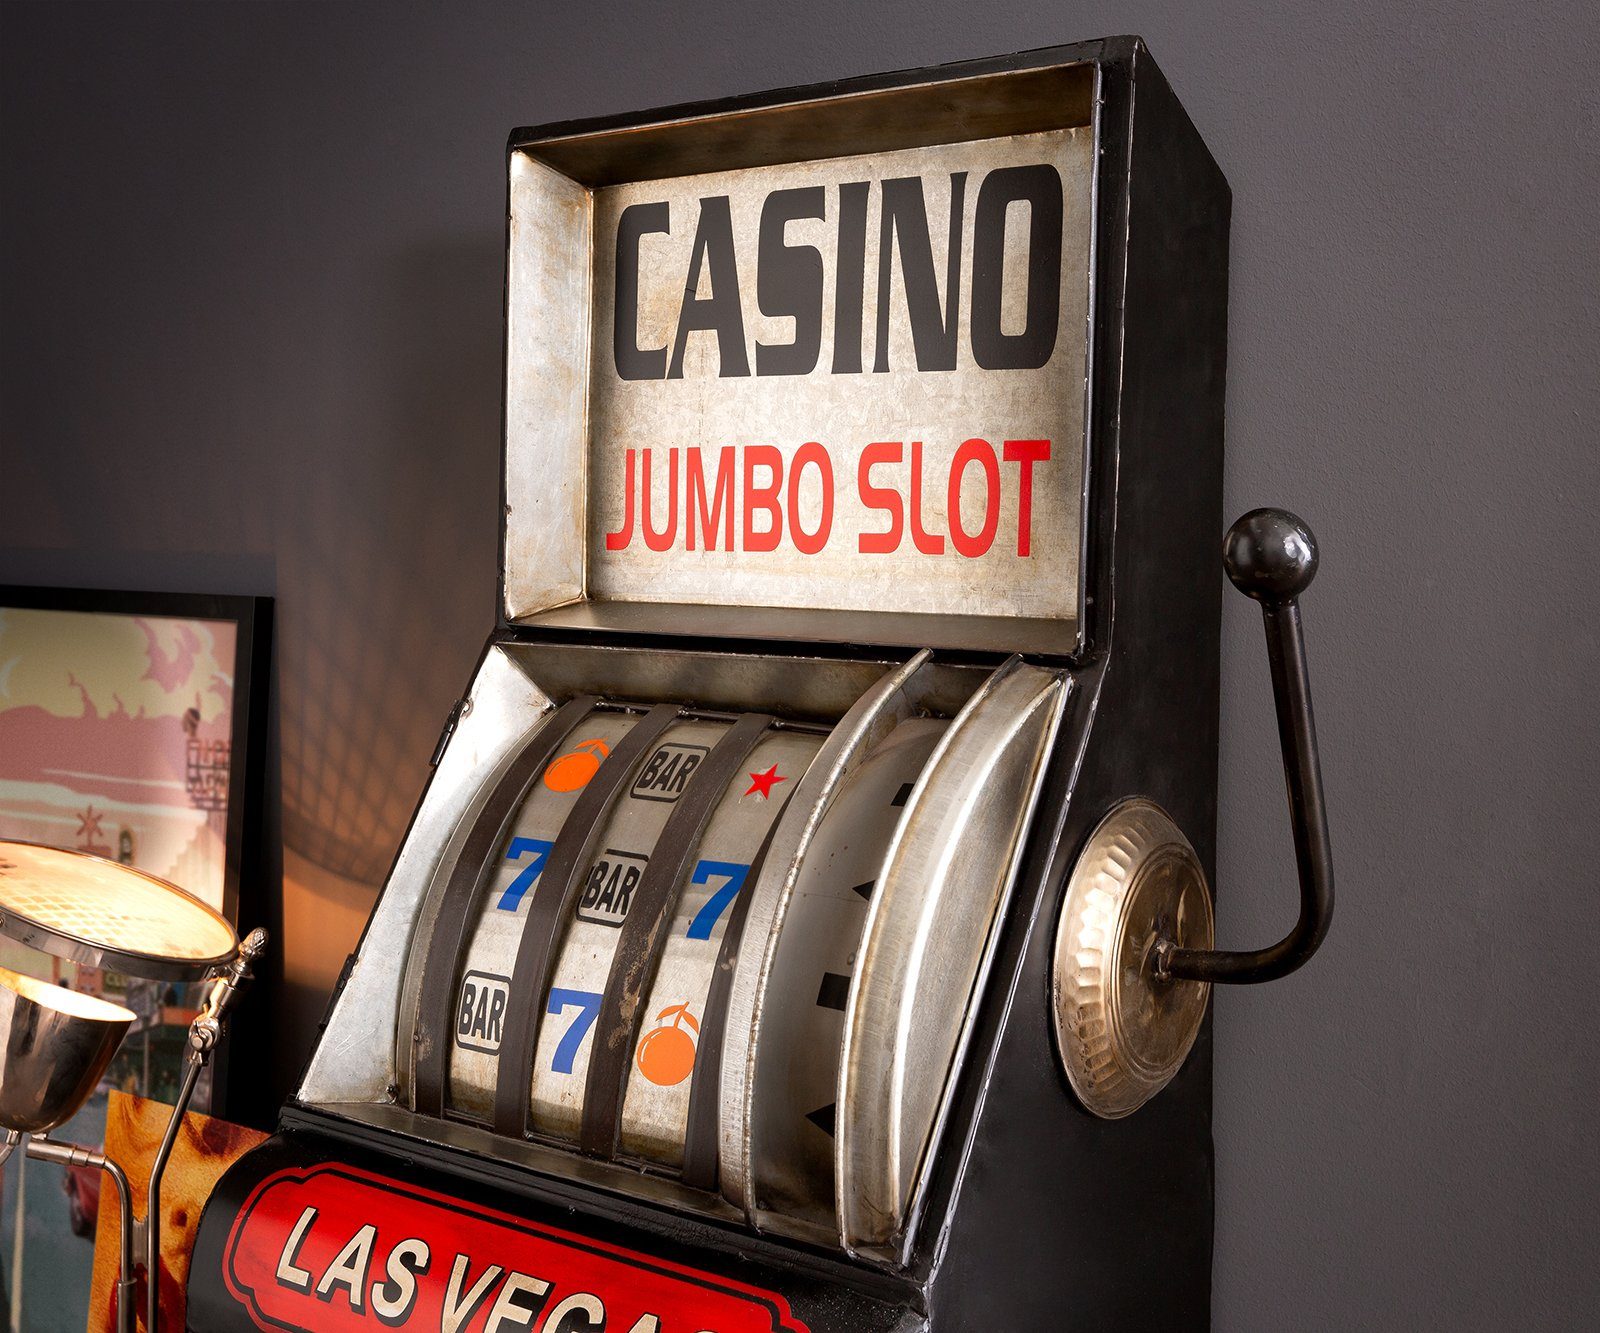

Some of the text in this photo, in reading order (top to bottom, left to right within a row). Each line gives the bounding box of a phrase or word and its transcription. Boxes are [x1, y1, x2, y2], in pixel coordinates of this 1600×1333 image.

[613, 163, 1063, 381] CASINO
[606, 438, 1051, 558] JUMBO SLOT
[636, 751, 701, 793] BAR
[497, 836, 555, 912] 7
[581, 861, 641, 915] BAR
[686, 860, 751, 941] 7
[458, 983, 506, 1043] BAR
[548, 988, 604, 1075] 7
[275, 1206, 430, 1319] LAS
